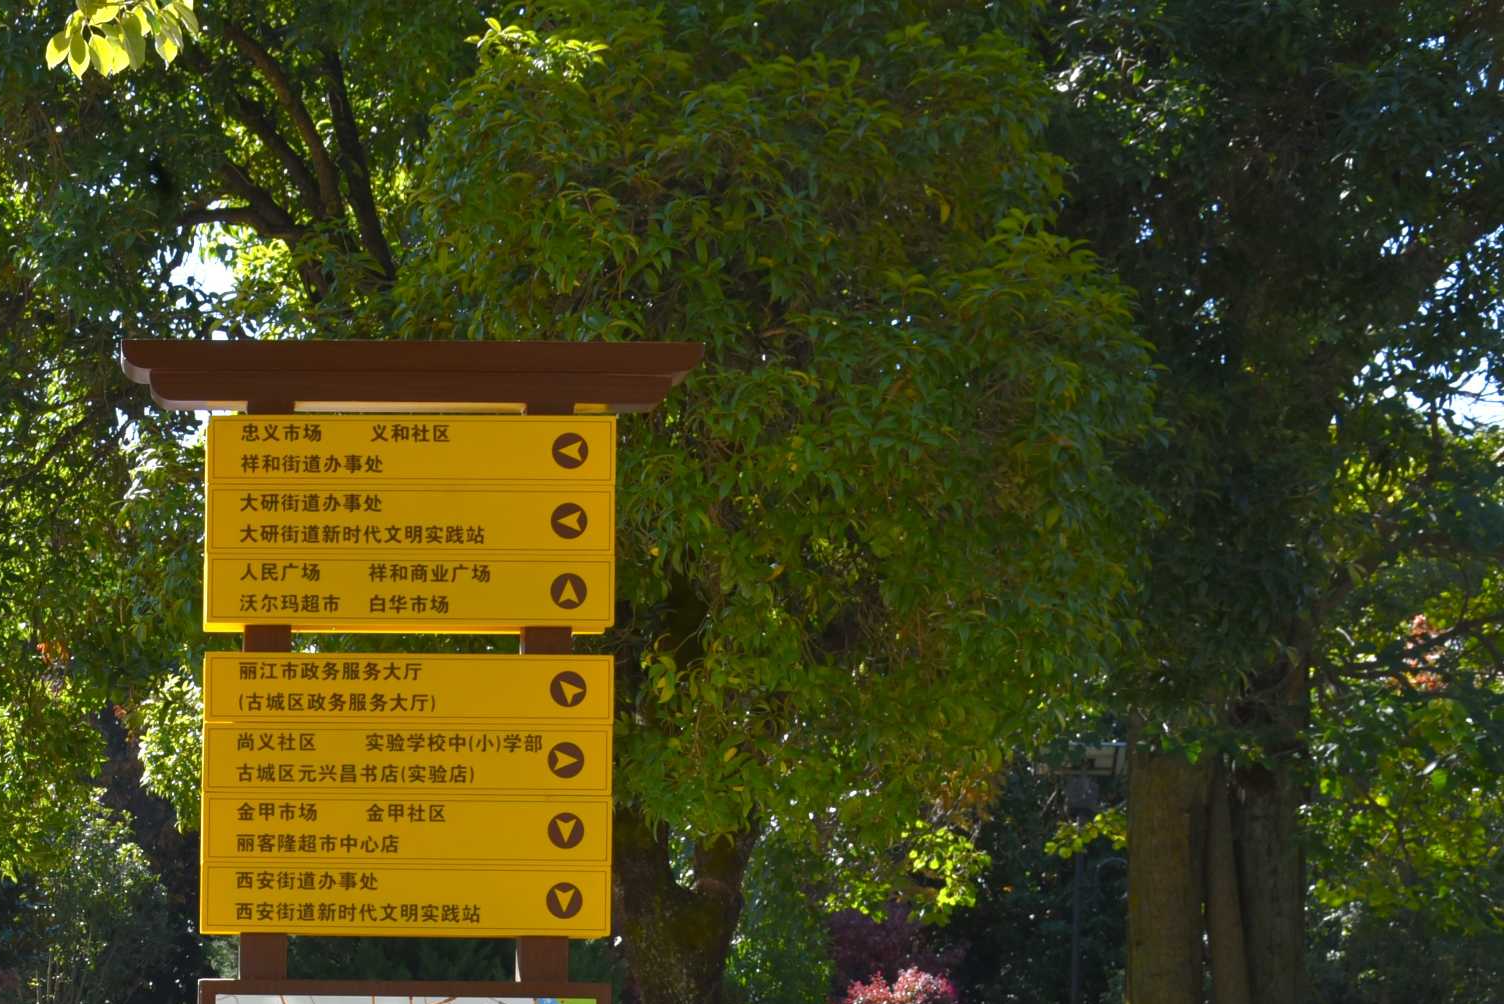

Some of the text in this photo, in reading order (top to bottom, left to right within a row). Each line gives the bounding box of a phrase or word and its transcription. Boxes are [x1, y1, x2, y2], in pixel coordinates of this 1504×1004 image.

[241, 423, 451, 443] 忠义市场 义和社区
[240, 454, 384, 474] 祥和街道办事处
[239, 493, 383, 513] 大研街道办事处
[239, 525, 486, 545] 大研街道新时代文明实践站
[239, 563, 491, 583] 人民广场 祥和商业广场
[239, 594, 450, 615] 沃尔玛超市 白华市场
[238, 661, 423, 682] 丽江市政务服务大厅
[237, 692, 437, 713] (古城区政务服务大厅)
[236, 732, 544, 754] 尚义社区 实验学校中(小)学部
[236, 764, 476, 785] 古城区元兴昌书店(实验店)
[236, 802, 447, 823] 金甲市场 金甲社区
[235, 833, 400, 854] 丽客隆超市中心店
[235, 870, 379, 891] 西安街道办事处
[235, 902, 481, 924] 西安街道新时代文明实践站
